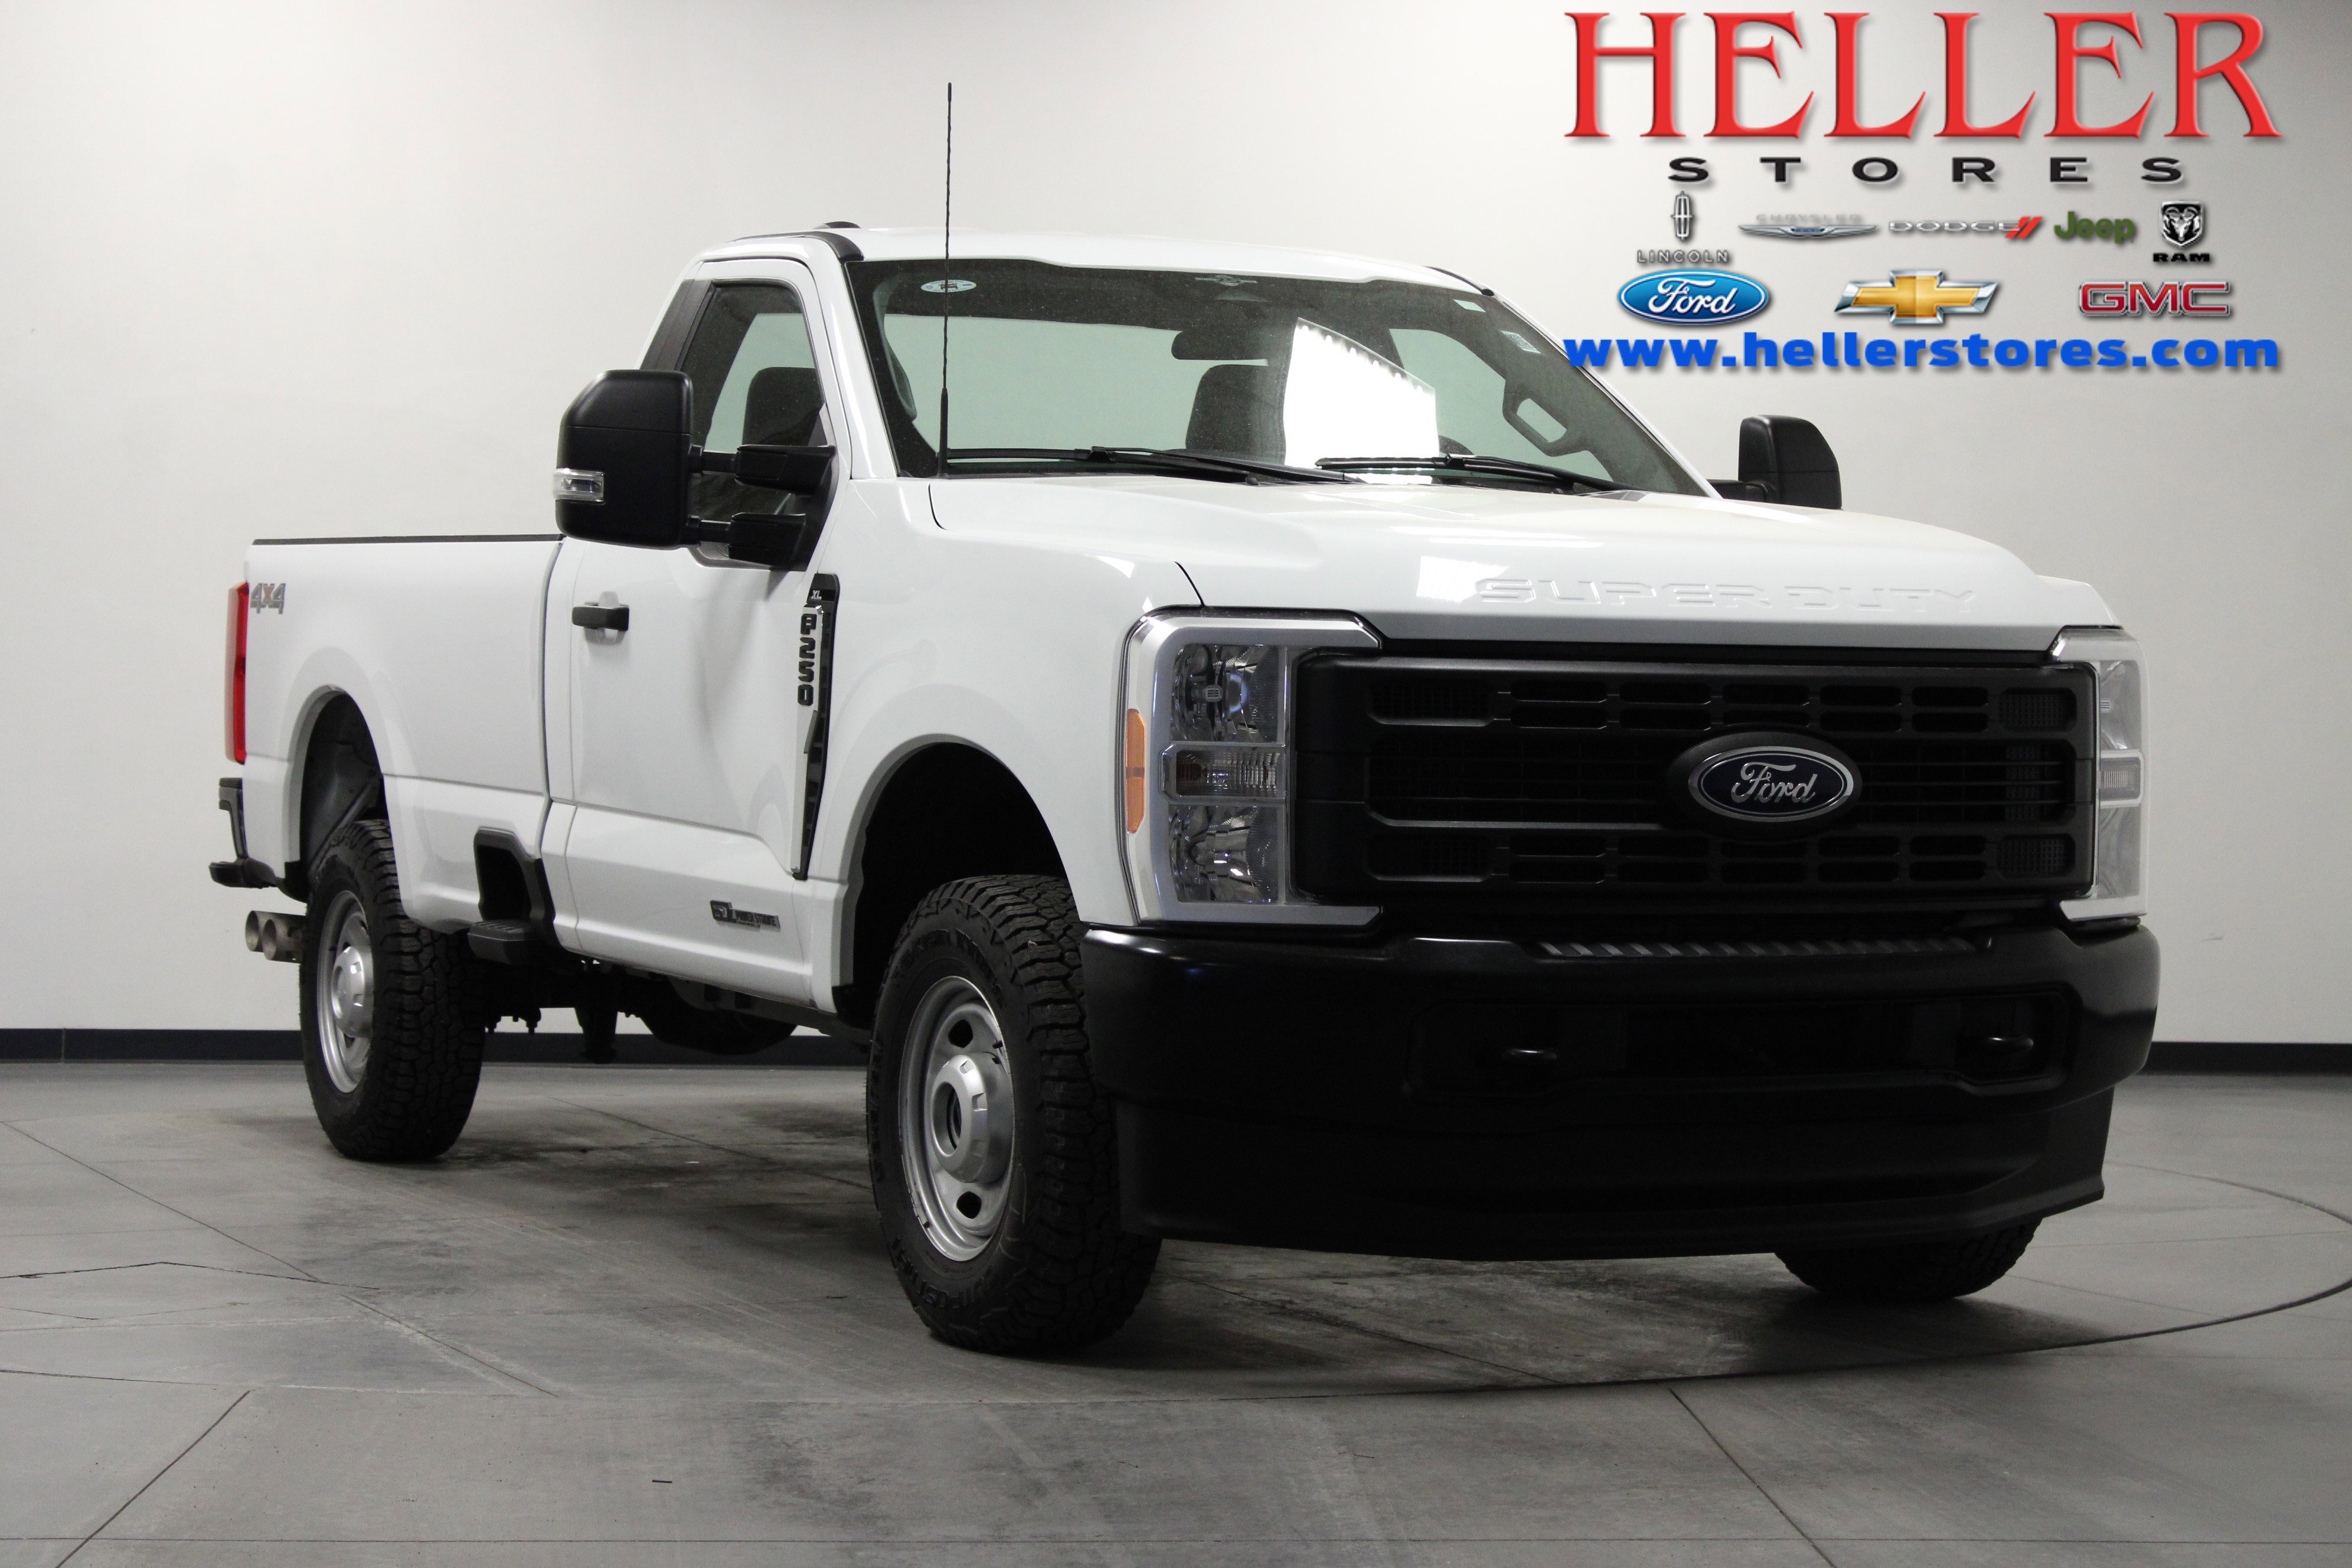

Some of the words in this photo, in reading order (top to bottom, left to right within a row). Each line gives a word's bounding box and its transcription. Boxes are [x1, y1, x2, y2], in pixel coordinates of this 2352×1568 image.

[811, 589, 822, 600] XL
[1475, 578, 1772, 609] SUPER
[1783, 585, 1974, 613] DUTY
[1730, 762, 1818, 803] Ford
